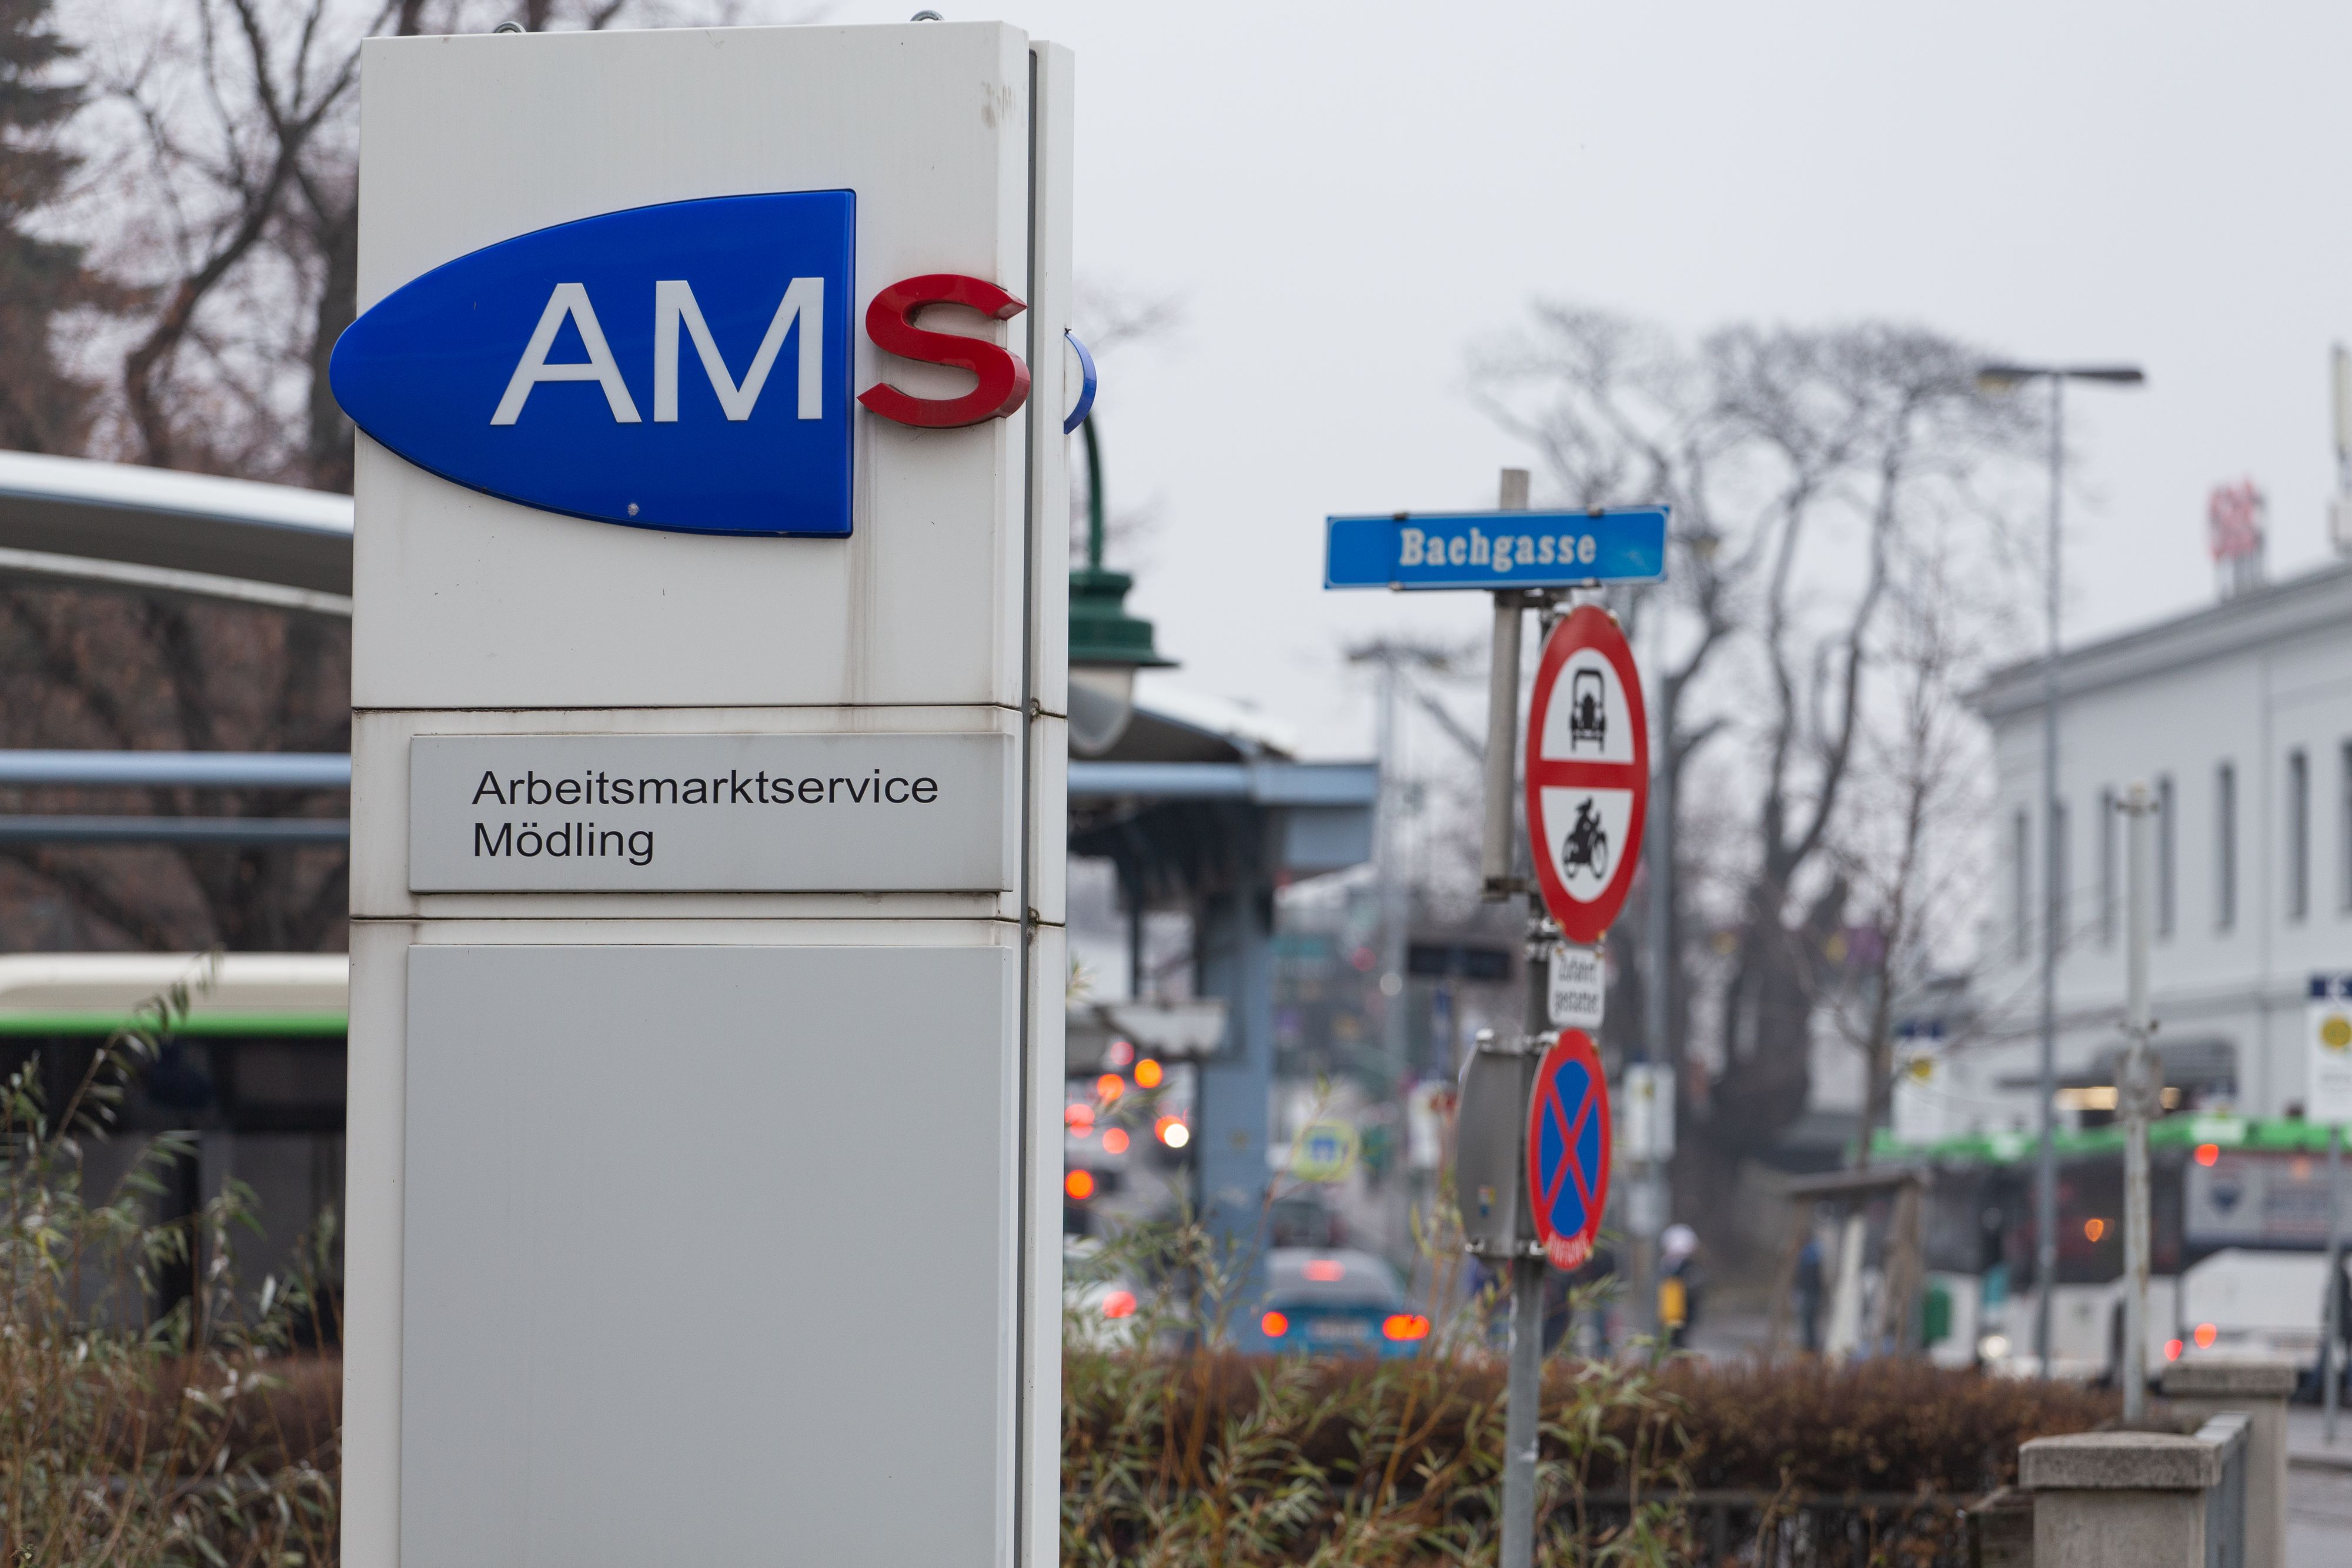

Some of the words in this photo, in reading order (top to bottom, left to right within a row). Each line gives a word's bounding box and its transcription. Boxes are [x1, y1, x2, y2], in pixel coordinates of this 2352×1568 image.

[489, 273, 1031, 429] AMS
[1399, 527, 1597, 573] Bachgasse
[472, 768, 938, 805] Arbeitsmarktservice
[474, 822, 653, 866] Mödling
